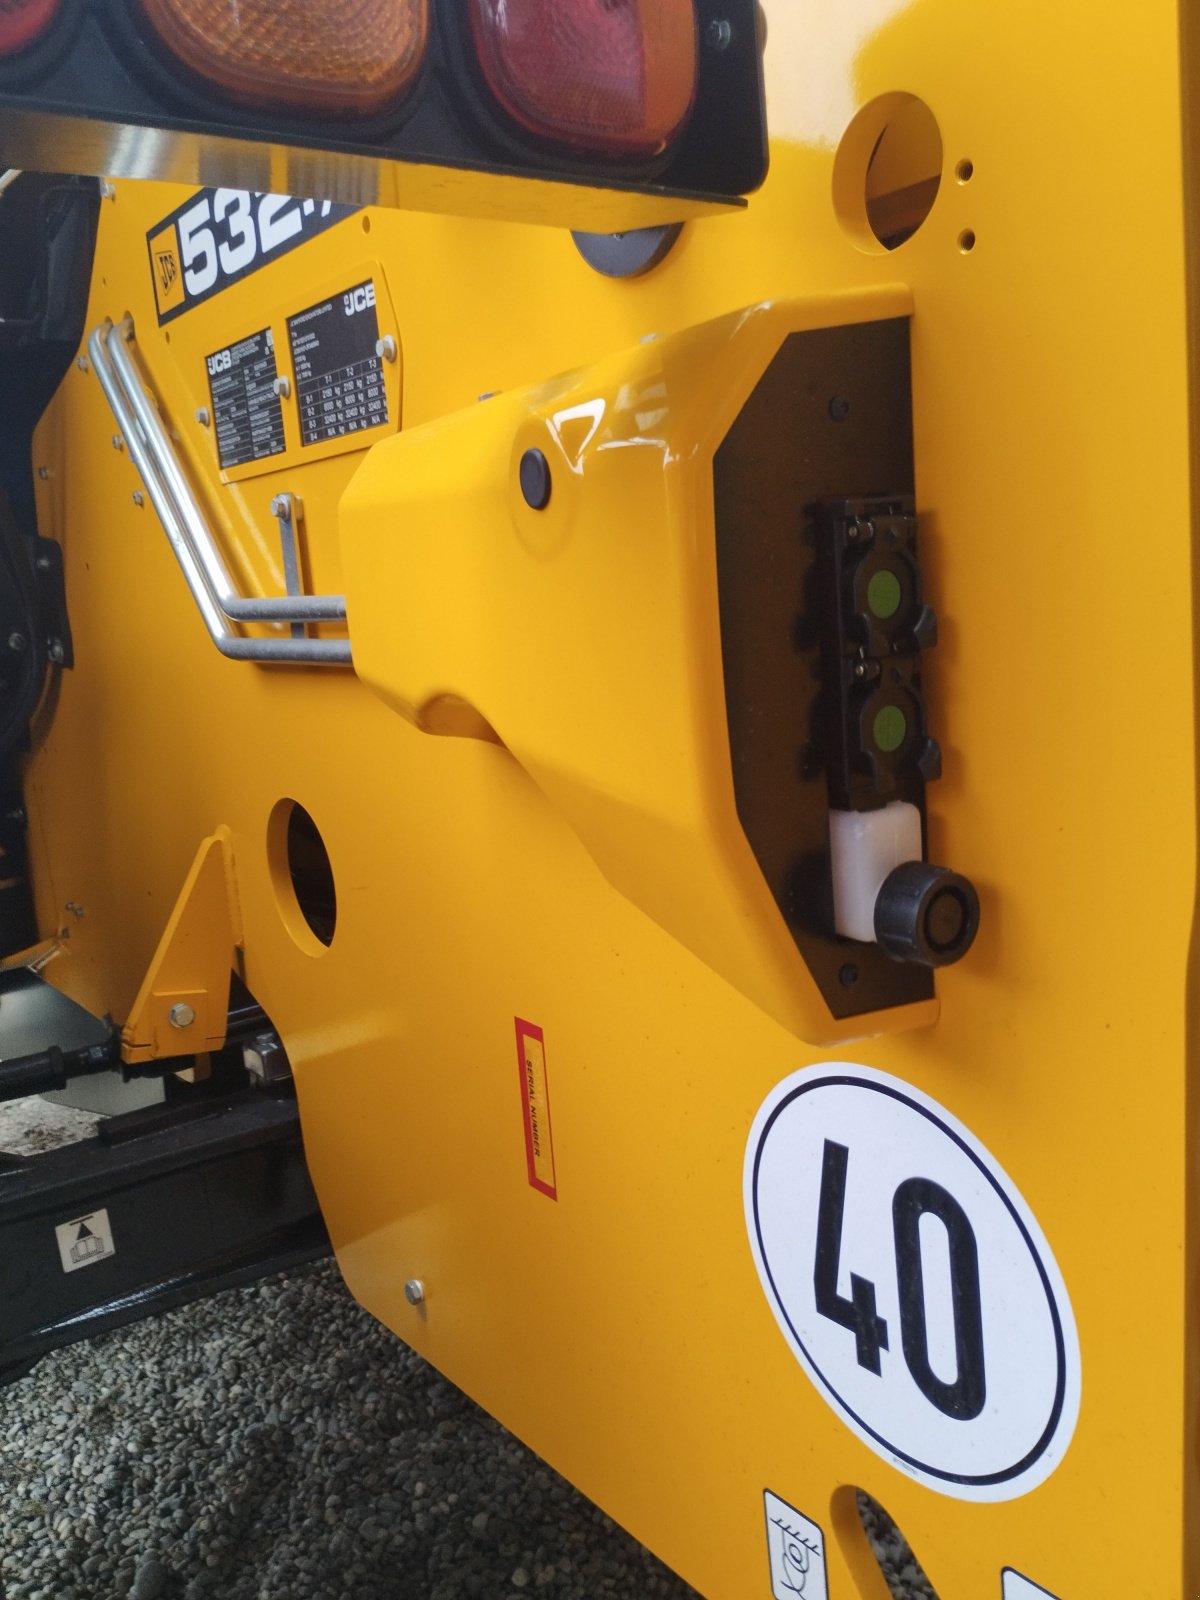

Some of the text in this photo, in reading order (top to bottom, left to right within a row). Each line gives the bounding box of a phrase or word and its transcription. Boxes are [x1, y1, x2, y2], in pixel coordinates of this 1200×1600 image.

[159, 254, 176, 289] JCB
[207, 350, 231, 375] JCB
[526, 1059, 540, 1157] SERIAL NUMBER
[814, 1138, 986, 1421] 40
